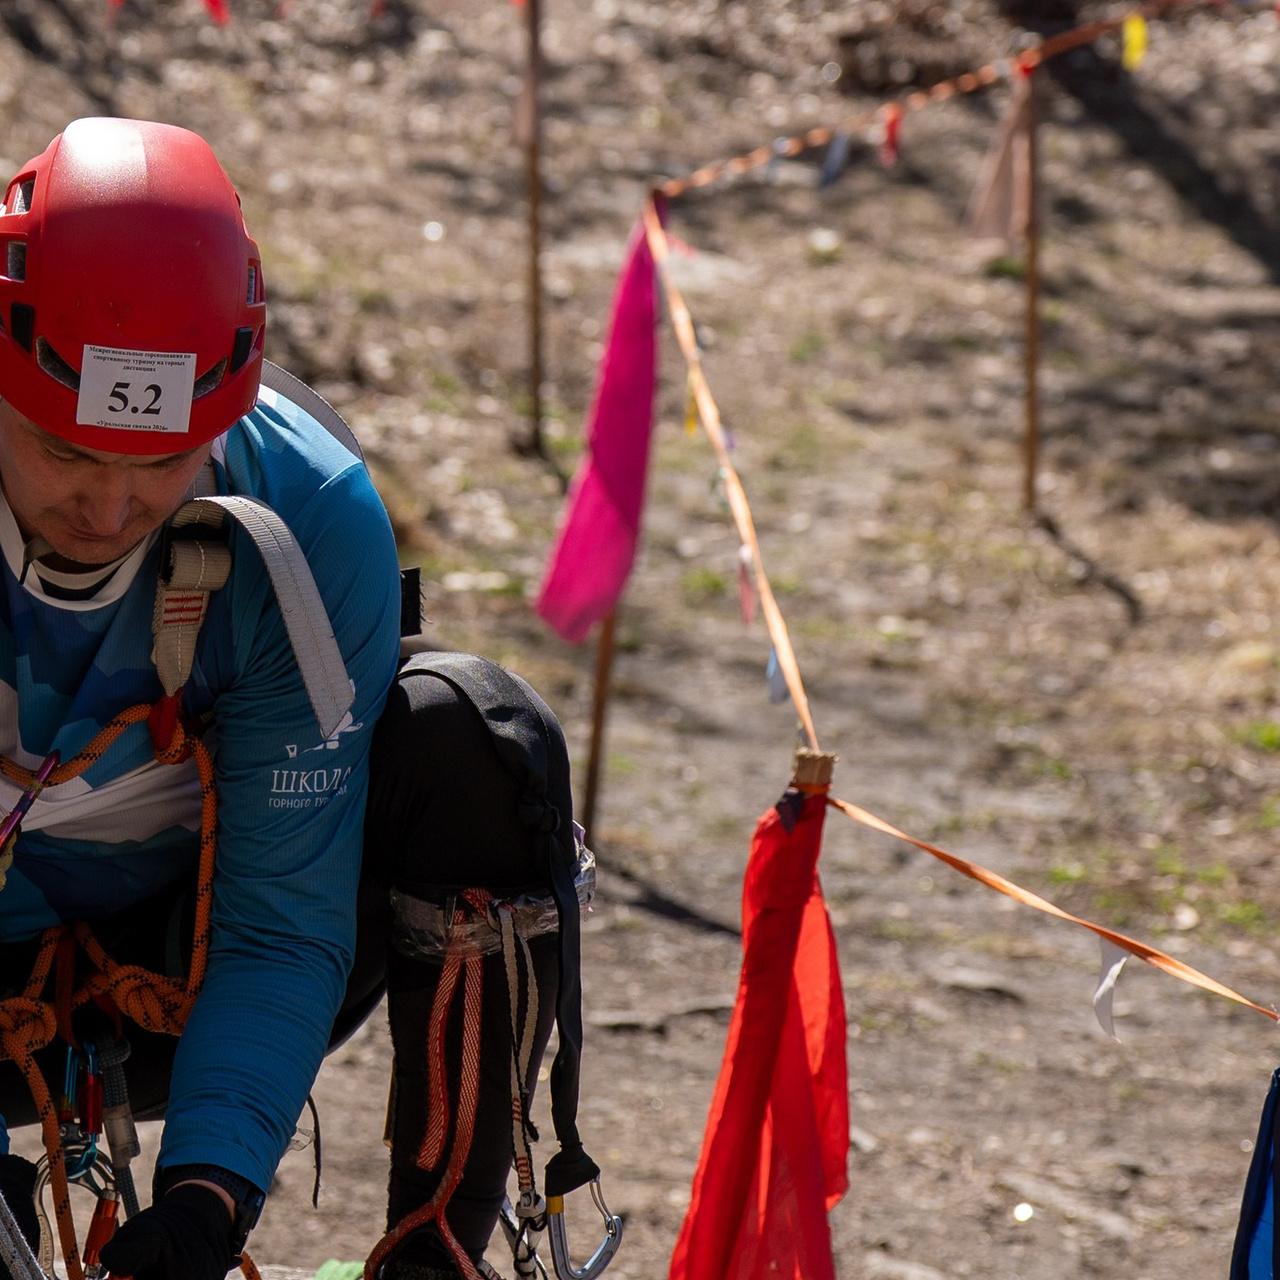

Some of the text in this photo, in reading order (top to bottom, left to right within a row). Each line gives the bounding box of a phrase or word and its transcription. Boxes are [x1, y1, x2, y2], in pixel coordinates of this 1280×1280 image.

[89, 346, 144, 357] Межрегиональные
[93, 354, 131, 364] спортивному
[132, 358, 156, 366] туризму
[107, 381, 162, 415] 5.2
[268, 797, 311, 808] ГОРНОГО
